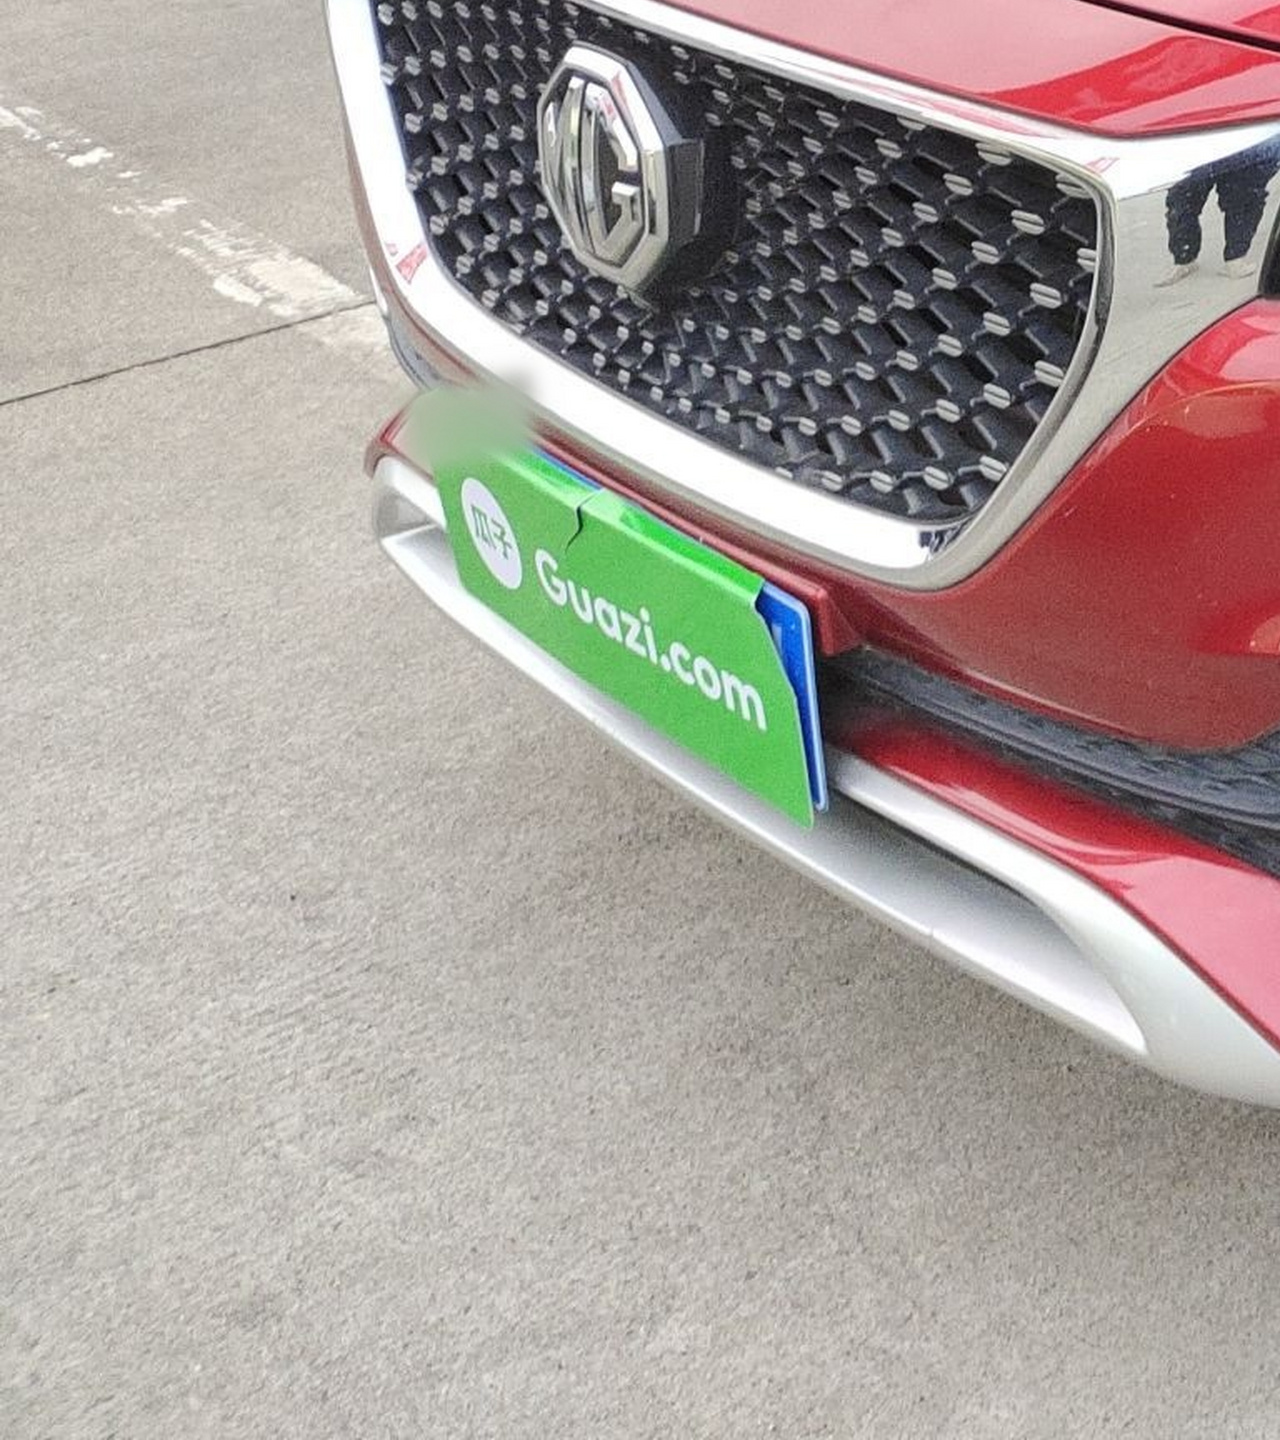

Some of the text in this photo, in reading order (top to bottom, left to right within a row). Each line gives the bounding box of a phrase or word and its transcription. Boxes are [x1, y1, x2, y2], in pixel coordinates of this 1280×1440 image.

[541, 72, 644, 268] MG
[470, 503, 513, 561] 瓜子
[535, 548, 768, 733] Guazi.com
